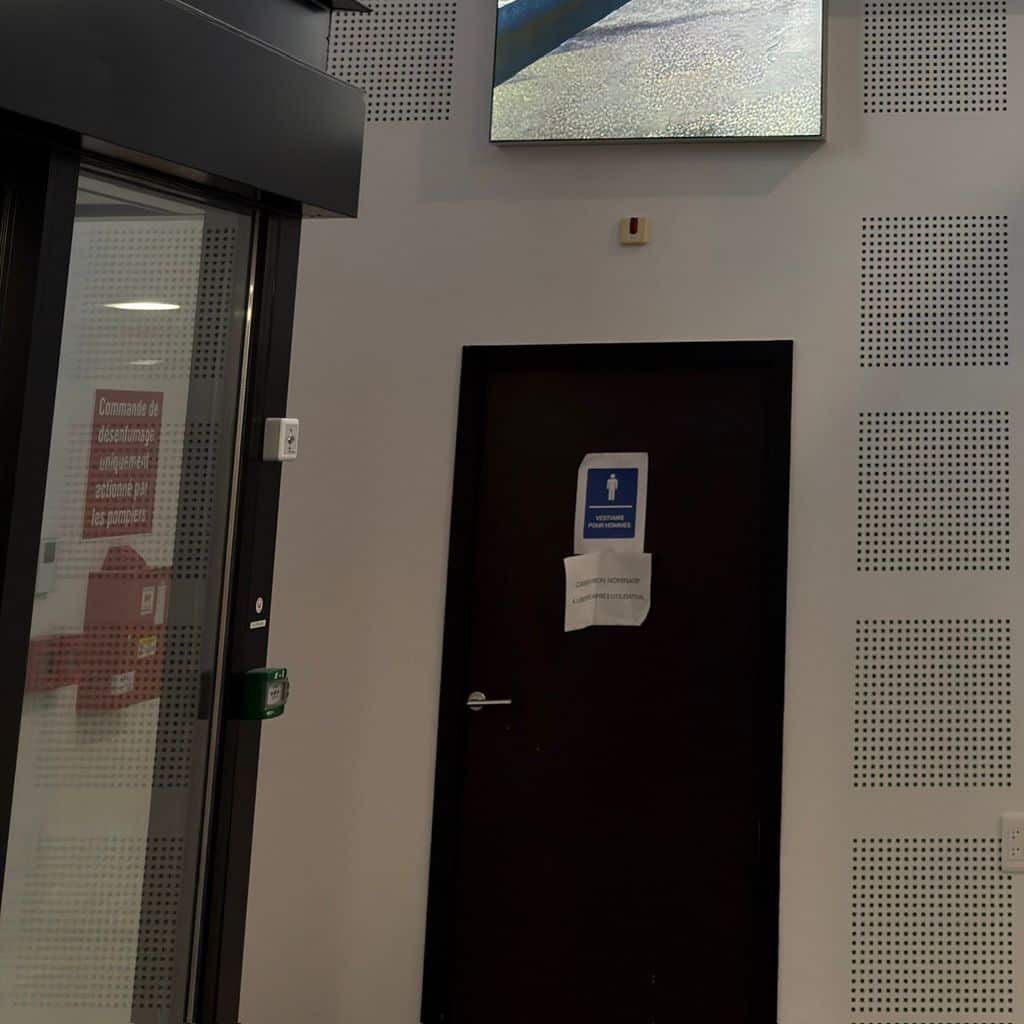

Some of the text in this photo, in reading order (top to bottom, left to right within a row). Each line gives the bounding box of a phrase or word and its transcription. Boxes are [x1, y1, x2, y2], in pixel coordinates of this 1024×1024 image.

[98, 397, 159, 417] Commande de
[97, 425, 155, 447] désenfumage
[98, 453, 149, 474] uniquement
[95, 479, 147, 502] actionné par
[91, 506, 146, 529] les pompiers
